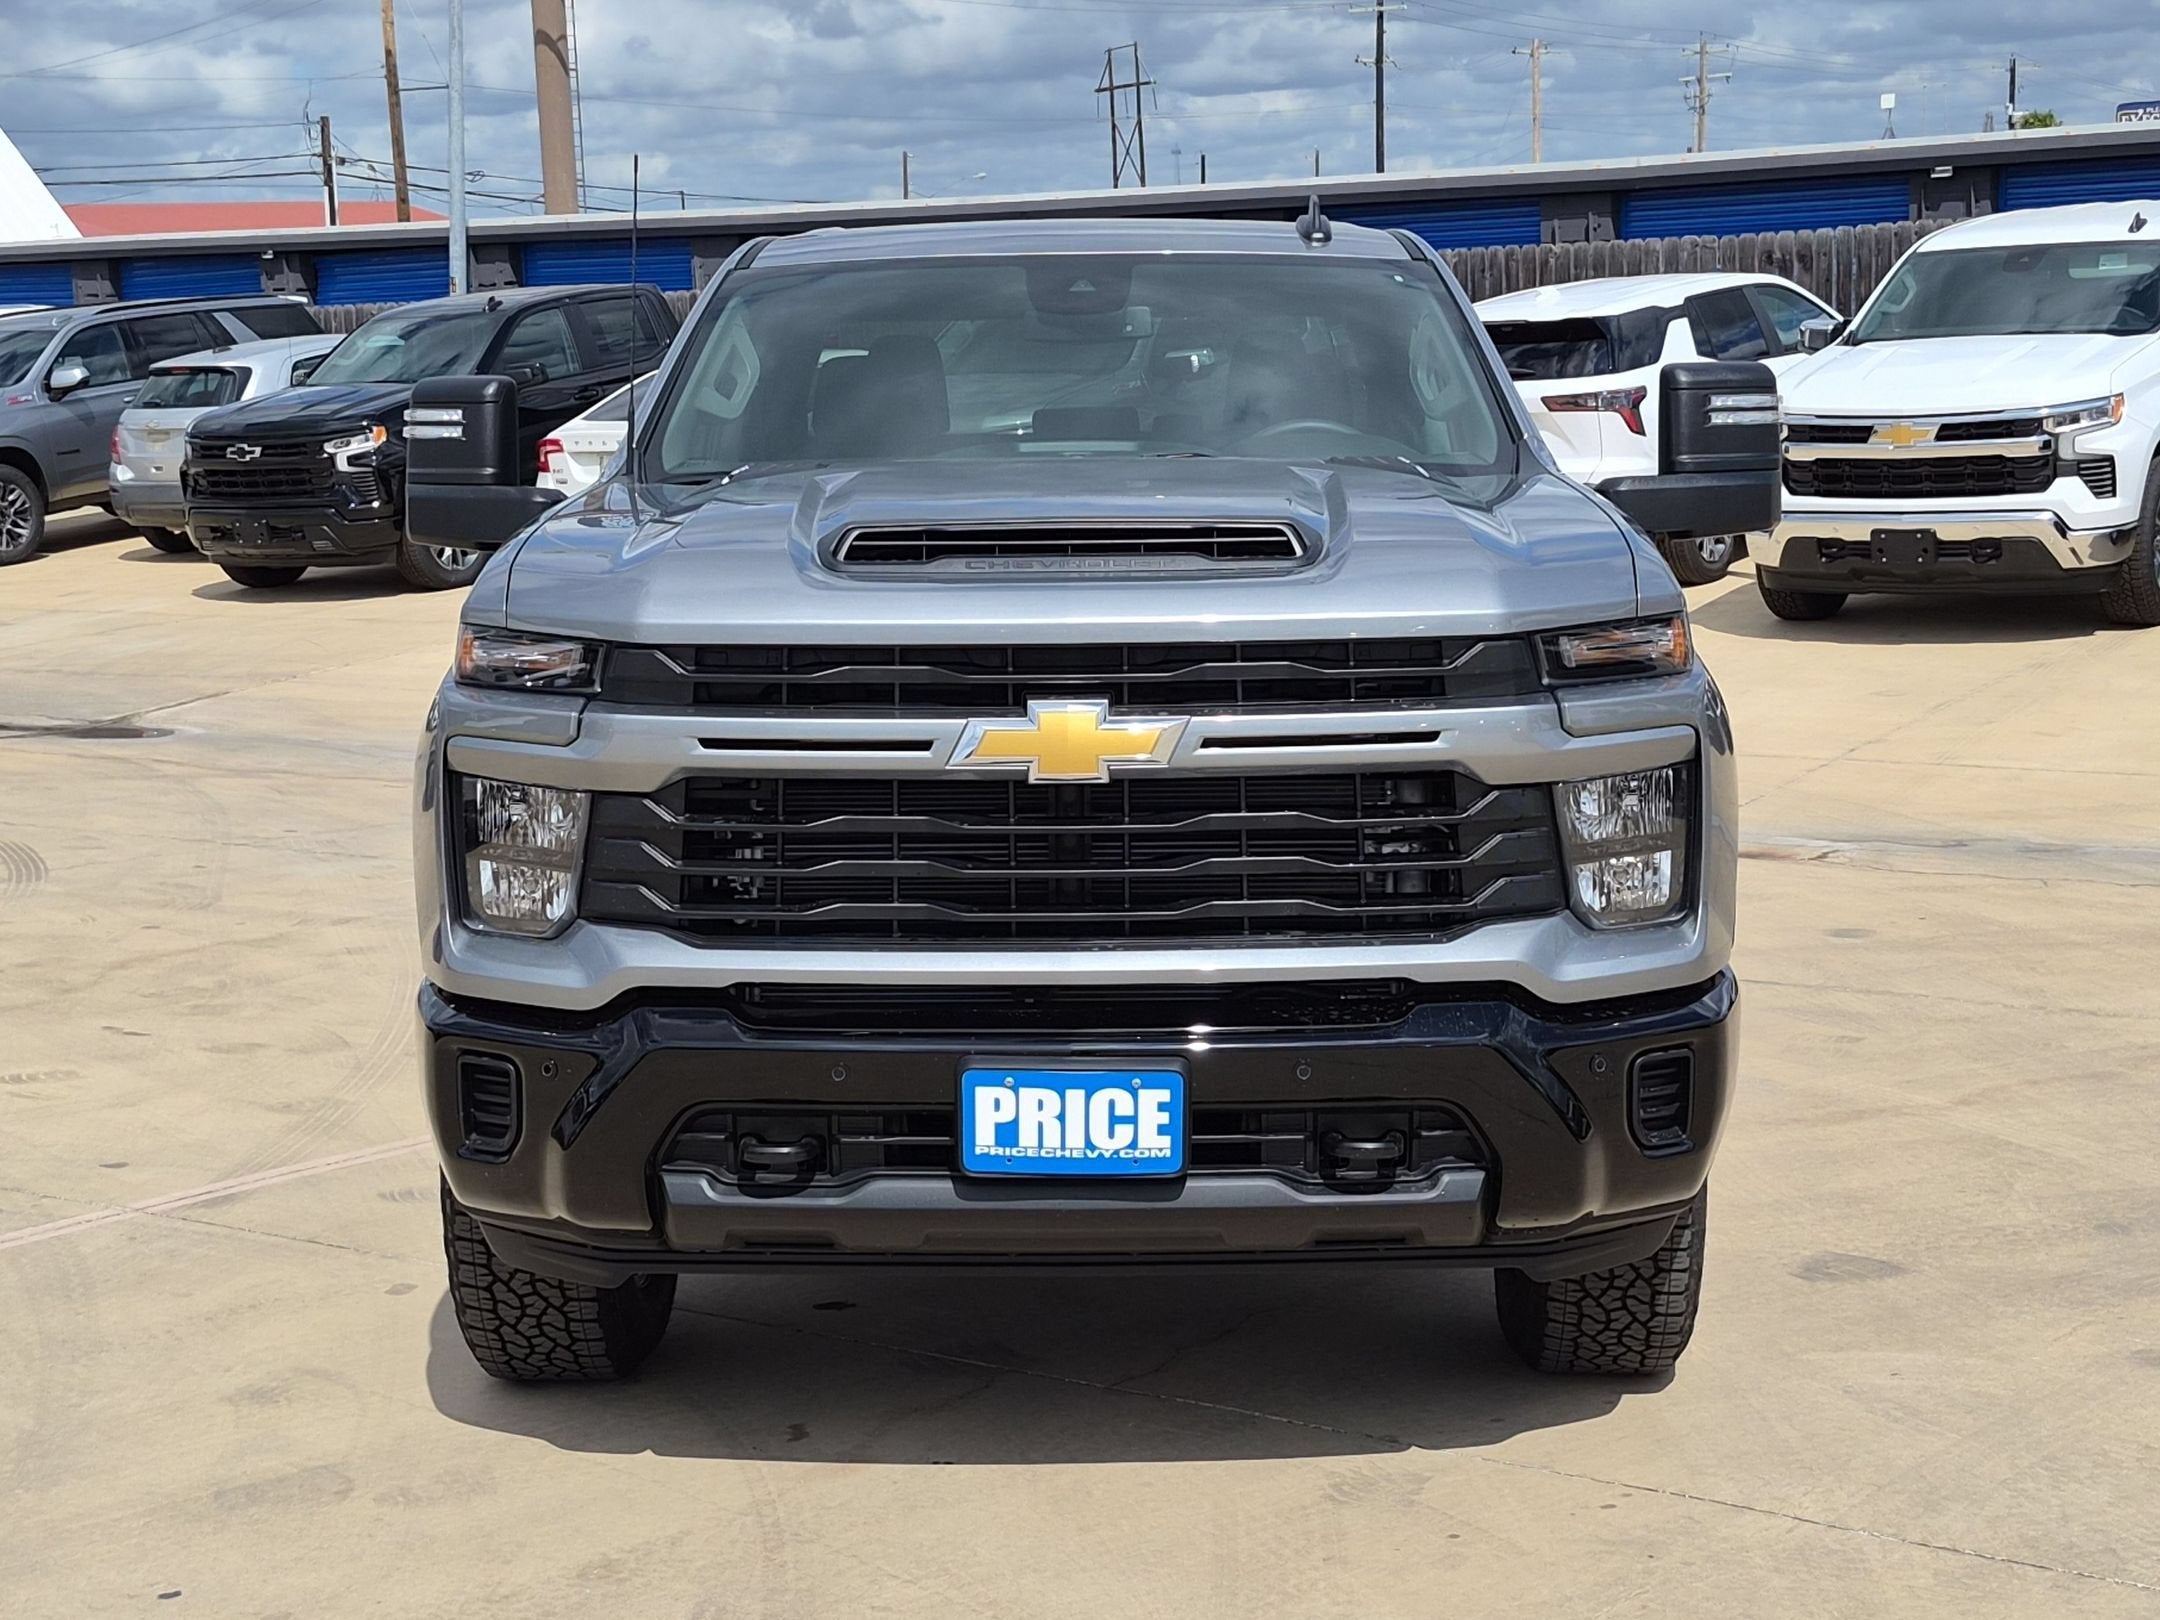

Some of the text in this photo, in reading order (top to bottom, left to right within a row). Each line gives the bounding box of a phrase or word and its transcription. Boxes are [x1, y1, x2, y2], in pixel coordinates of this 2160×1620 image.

[965, 559, 1172, 570] CHEVROLET
[974, 1086, 1172, 1149] PRICE
[974, 1146, 1172, 1158] PRICECHEVY.COM
